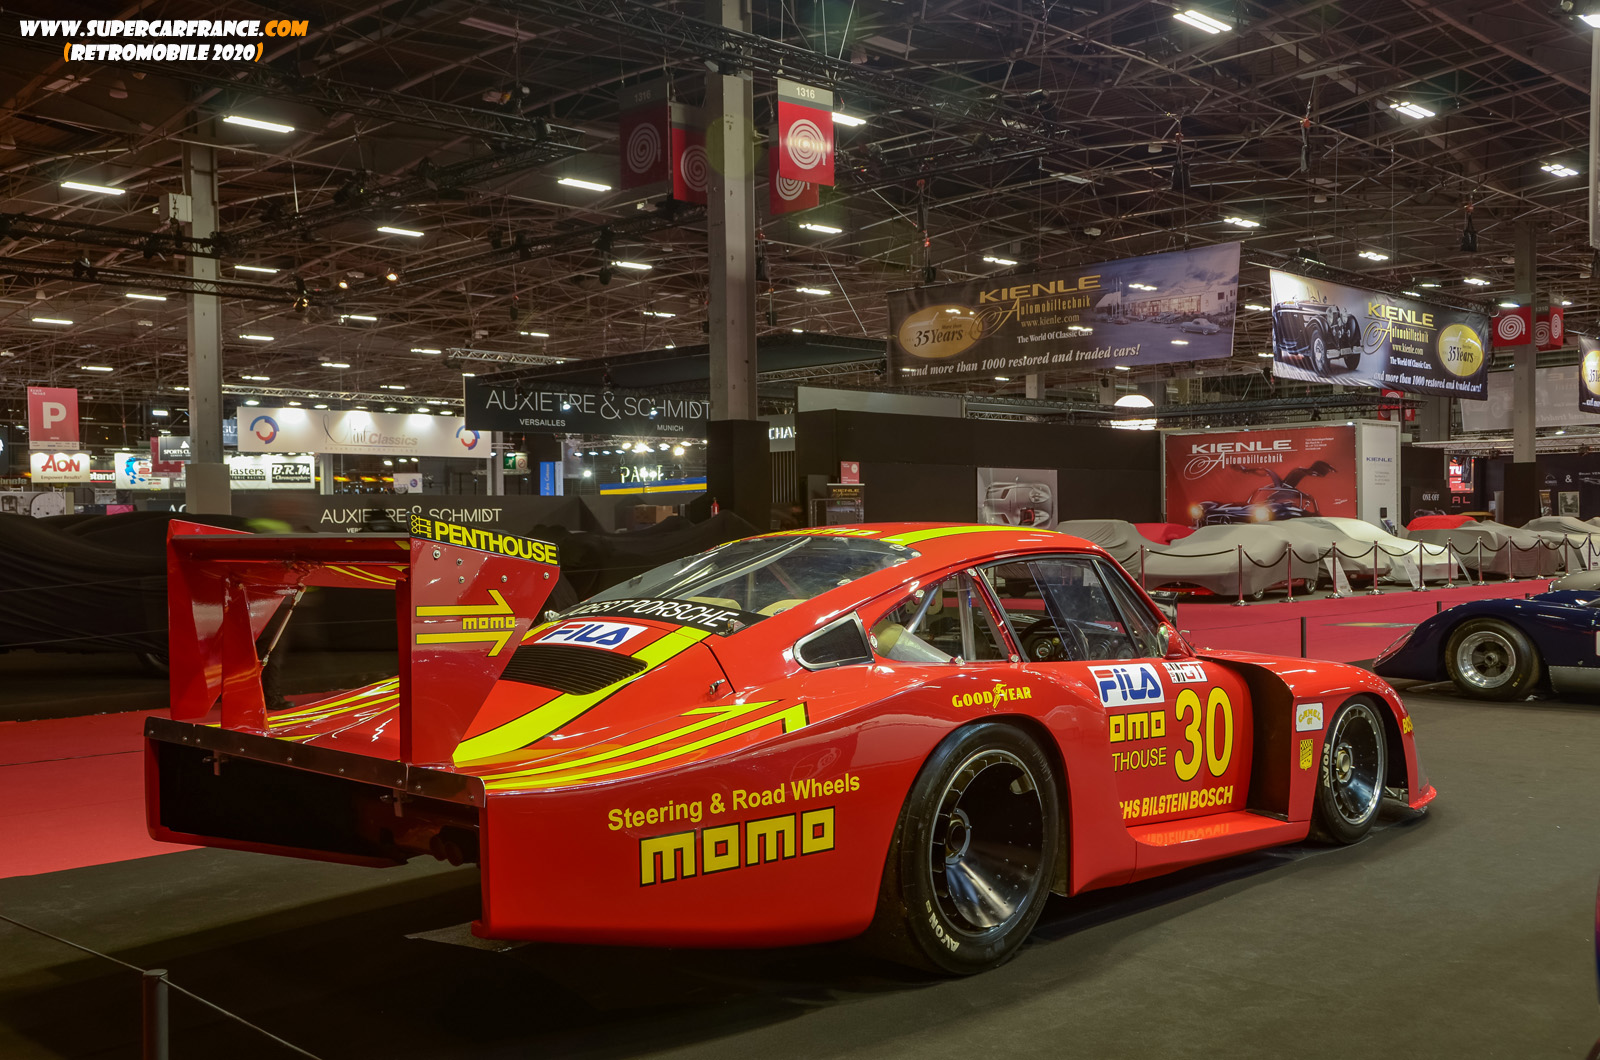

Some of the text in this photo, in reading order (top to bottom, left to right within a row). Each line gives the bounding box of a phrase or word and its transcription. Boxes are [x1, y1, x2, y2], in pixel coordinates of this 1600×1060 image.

[795, 86, 816, 99] 1316
[980, 274, 1101, 304] KIENLE
[1021, 314, 1080, 328] www.kienle.com
[1367, 302, 1434, 327] KIENLE
[1017, 335, 1028, 343] The
[1029, 333, 1046, 342] World
[1056, 330, 1078, 339] Classic
[930, 363, 953, 375] more
[956, 361, 978, 374] than
[981, 359, 1006, 370] 1000
[1008, 355, 1049, 369] restored
[1051, 351, 1073, 363] and
[1075, 347, 1112, 360] traded
[1113, 343, 1141, 357] cars!
[1385, 372, 1399, 383] more
[1400, 372, 1412, 385] than
[1412, 375, 1425, 386] 1000
[1425, 377, 1445, 389] restored
[1445, 380, 1455, 390] and
[42, 401, 67, 429] P
[485, 389, 710, 420] AUXIETRE & SCHMIDT
[519, 418, 566, 427] VERSAILLES
[656, 424, 684, 432] MUNICH
[368, 432, 419, 446] Classics
[1191, 439, 1292, 454] KIENLE
[434, 520, 559, 566] PENTHOUSE
[618, 599, 740, 628] PORSCHE
[541, 623, 631, 645] FILA
[1099, 666, 1162, 703] FILA
[1298, 708, 1322, 723] CAMEL
[1173, 685, 1235, 782] 30
[1323, 743, 1331, 788] AVON
[607, 773, 861, 832] Steering & Road Wheels
[1141, 791, 1189, 818] BILSTEIN
[1189, 785, 1234, 809] BOSCH
